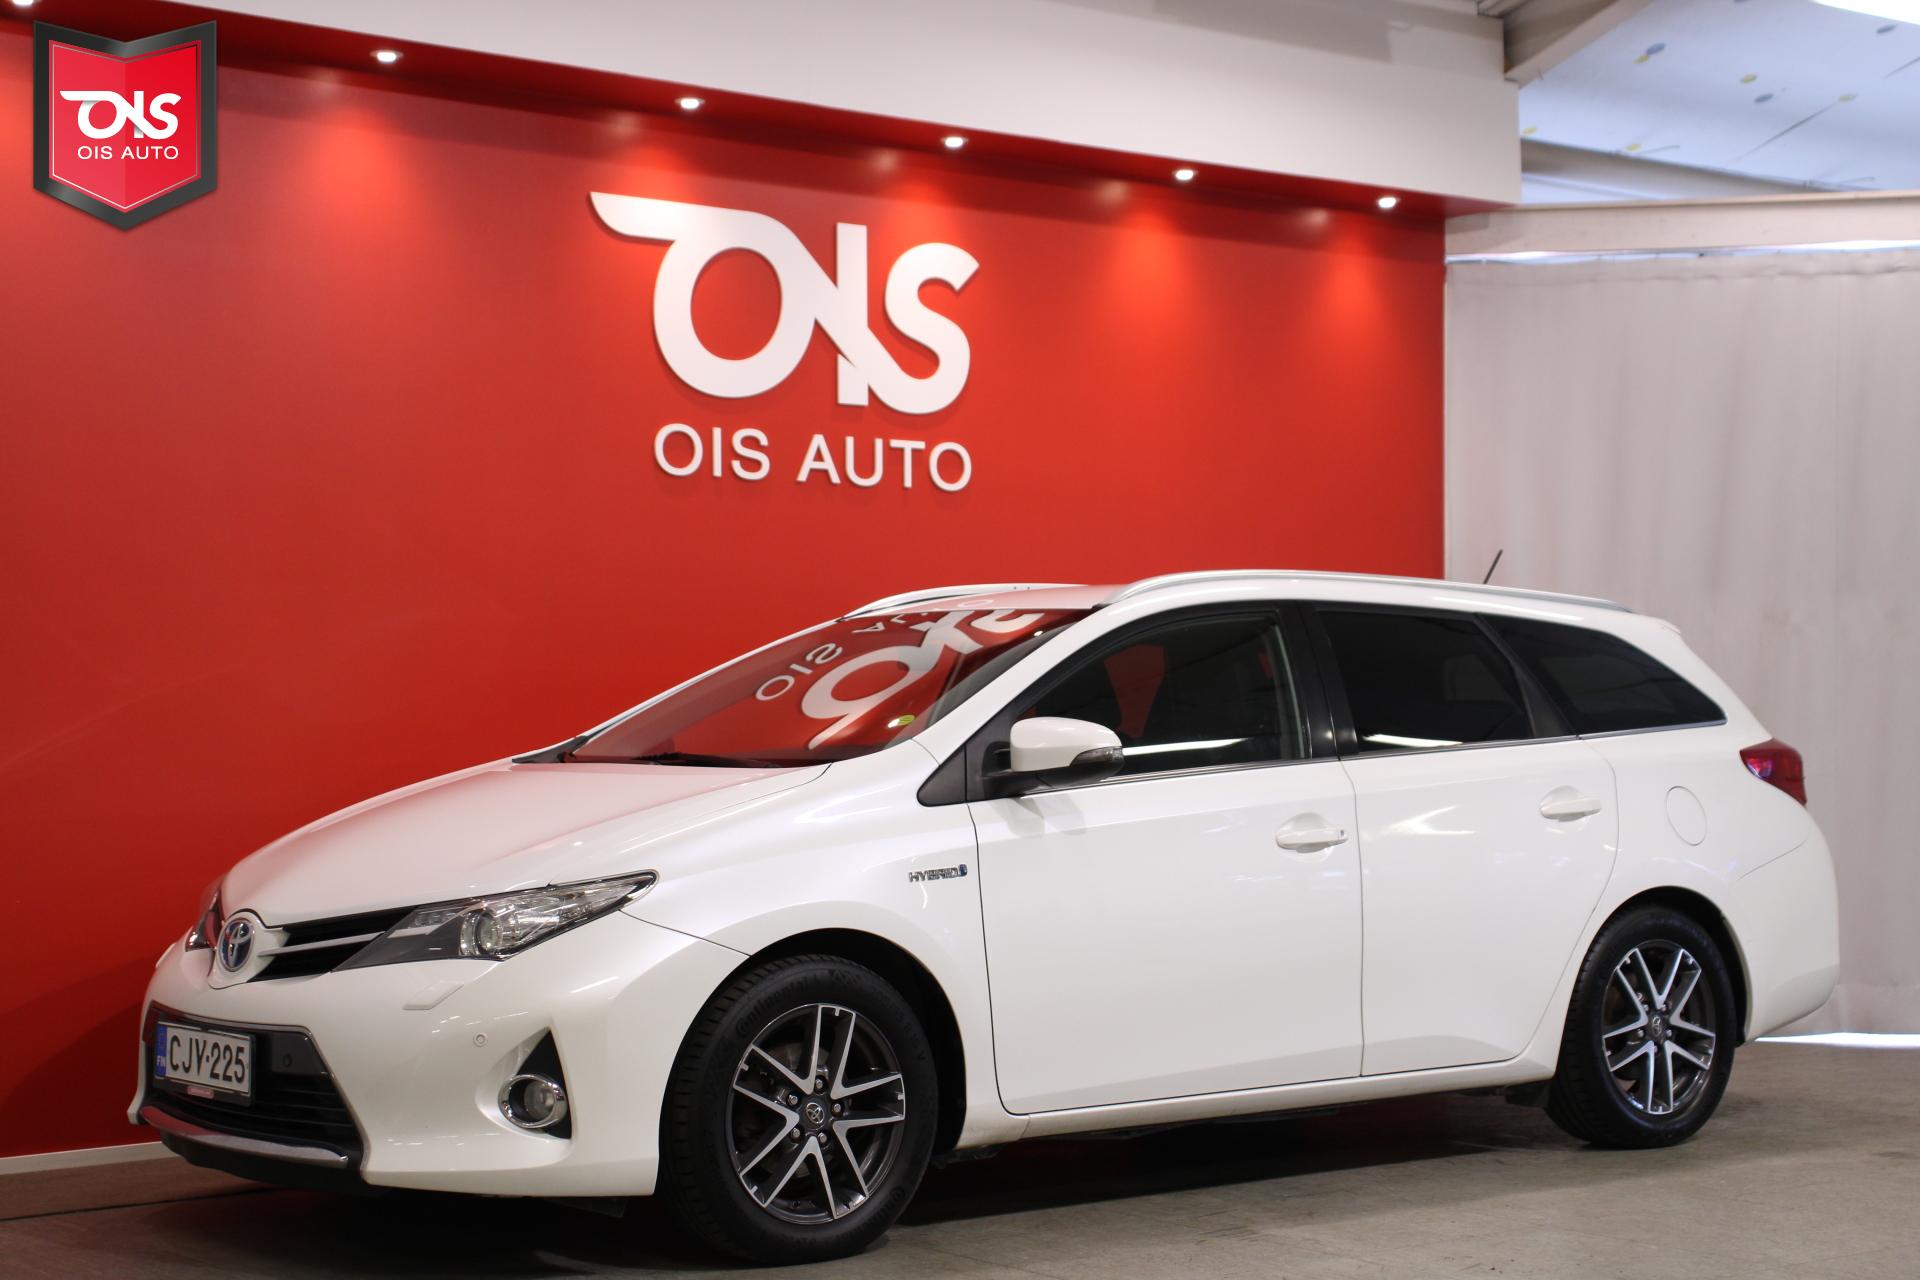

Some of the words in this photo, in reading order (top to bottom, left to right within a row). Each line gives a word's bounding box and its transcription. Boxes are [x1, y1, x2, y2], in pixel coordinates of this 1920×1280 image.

[654, 423, 770, 481] OIS
[796, 433, 973, 492] AUTO
[909, 867, 960, 882] HYBRID
